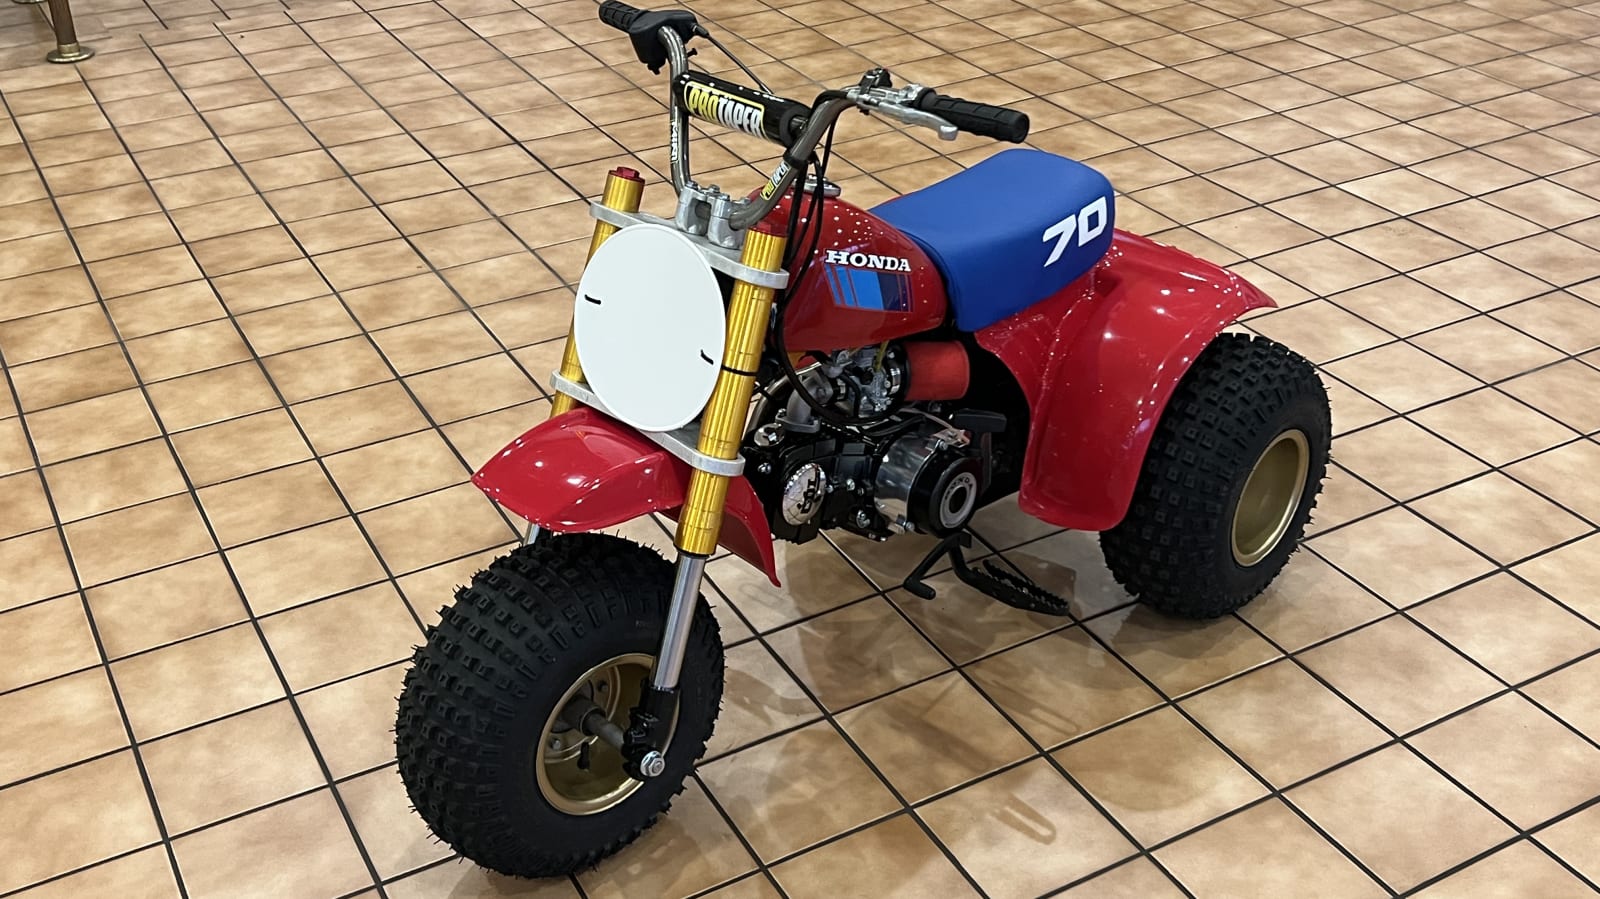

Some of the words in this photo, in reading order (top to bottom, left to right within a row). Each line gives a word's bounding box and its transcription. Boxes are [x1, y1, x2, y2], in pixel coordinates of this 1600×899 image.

[689, 85, 762, 140] PROTAPER
[1042, 196, 1107, 267] 70
[825, 249, 912, 272] HONDA
